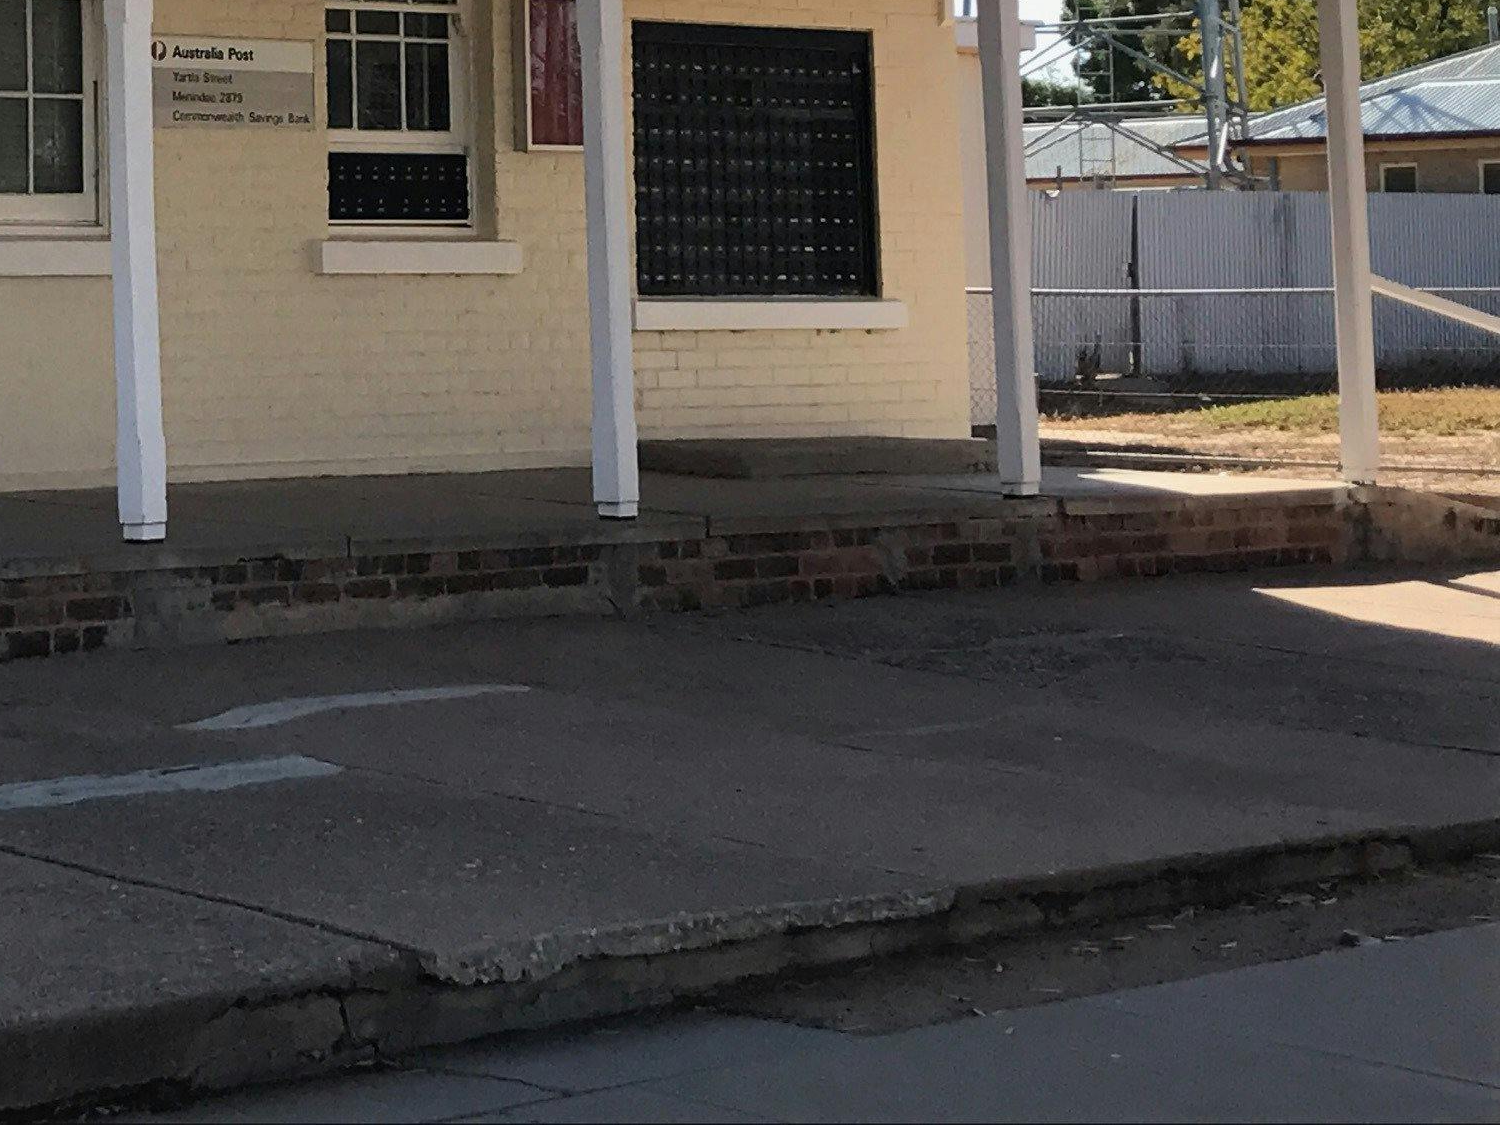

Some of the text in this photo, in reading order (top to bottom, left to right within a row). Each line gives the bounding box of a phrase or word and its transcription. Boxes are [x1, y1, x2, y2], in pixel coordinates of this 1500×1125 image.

[172, 45, 254, 61] Australia Post
[204, 73, 233, 84] Street
[172, 91, 243, 104] Menindee 2879
[172, 110, 310, 125] Commonwealth Savings Bank
